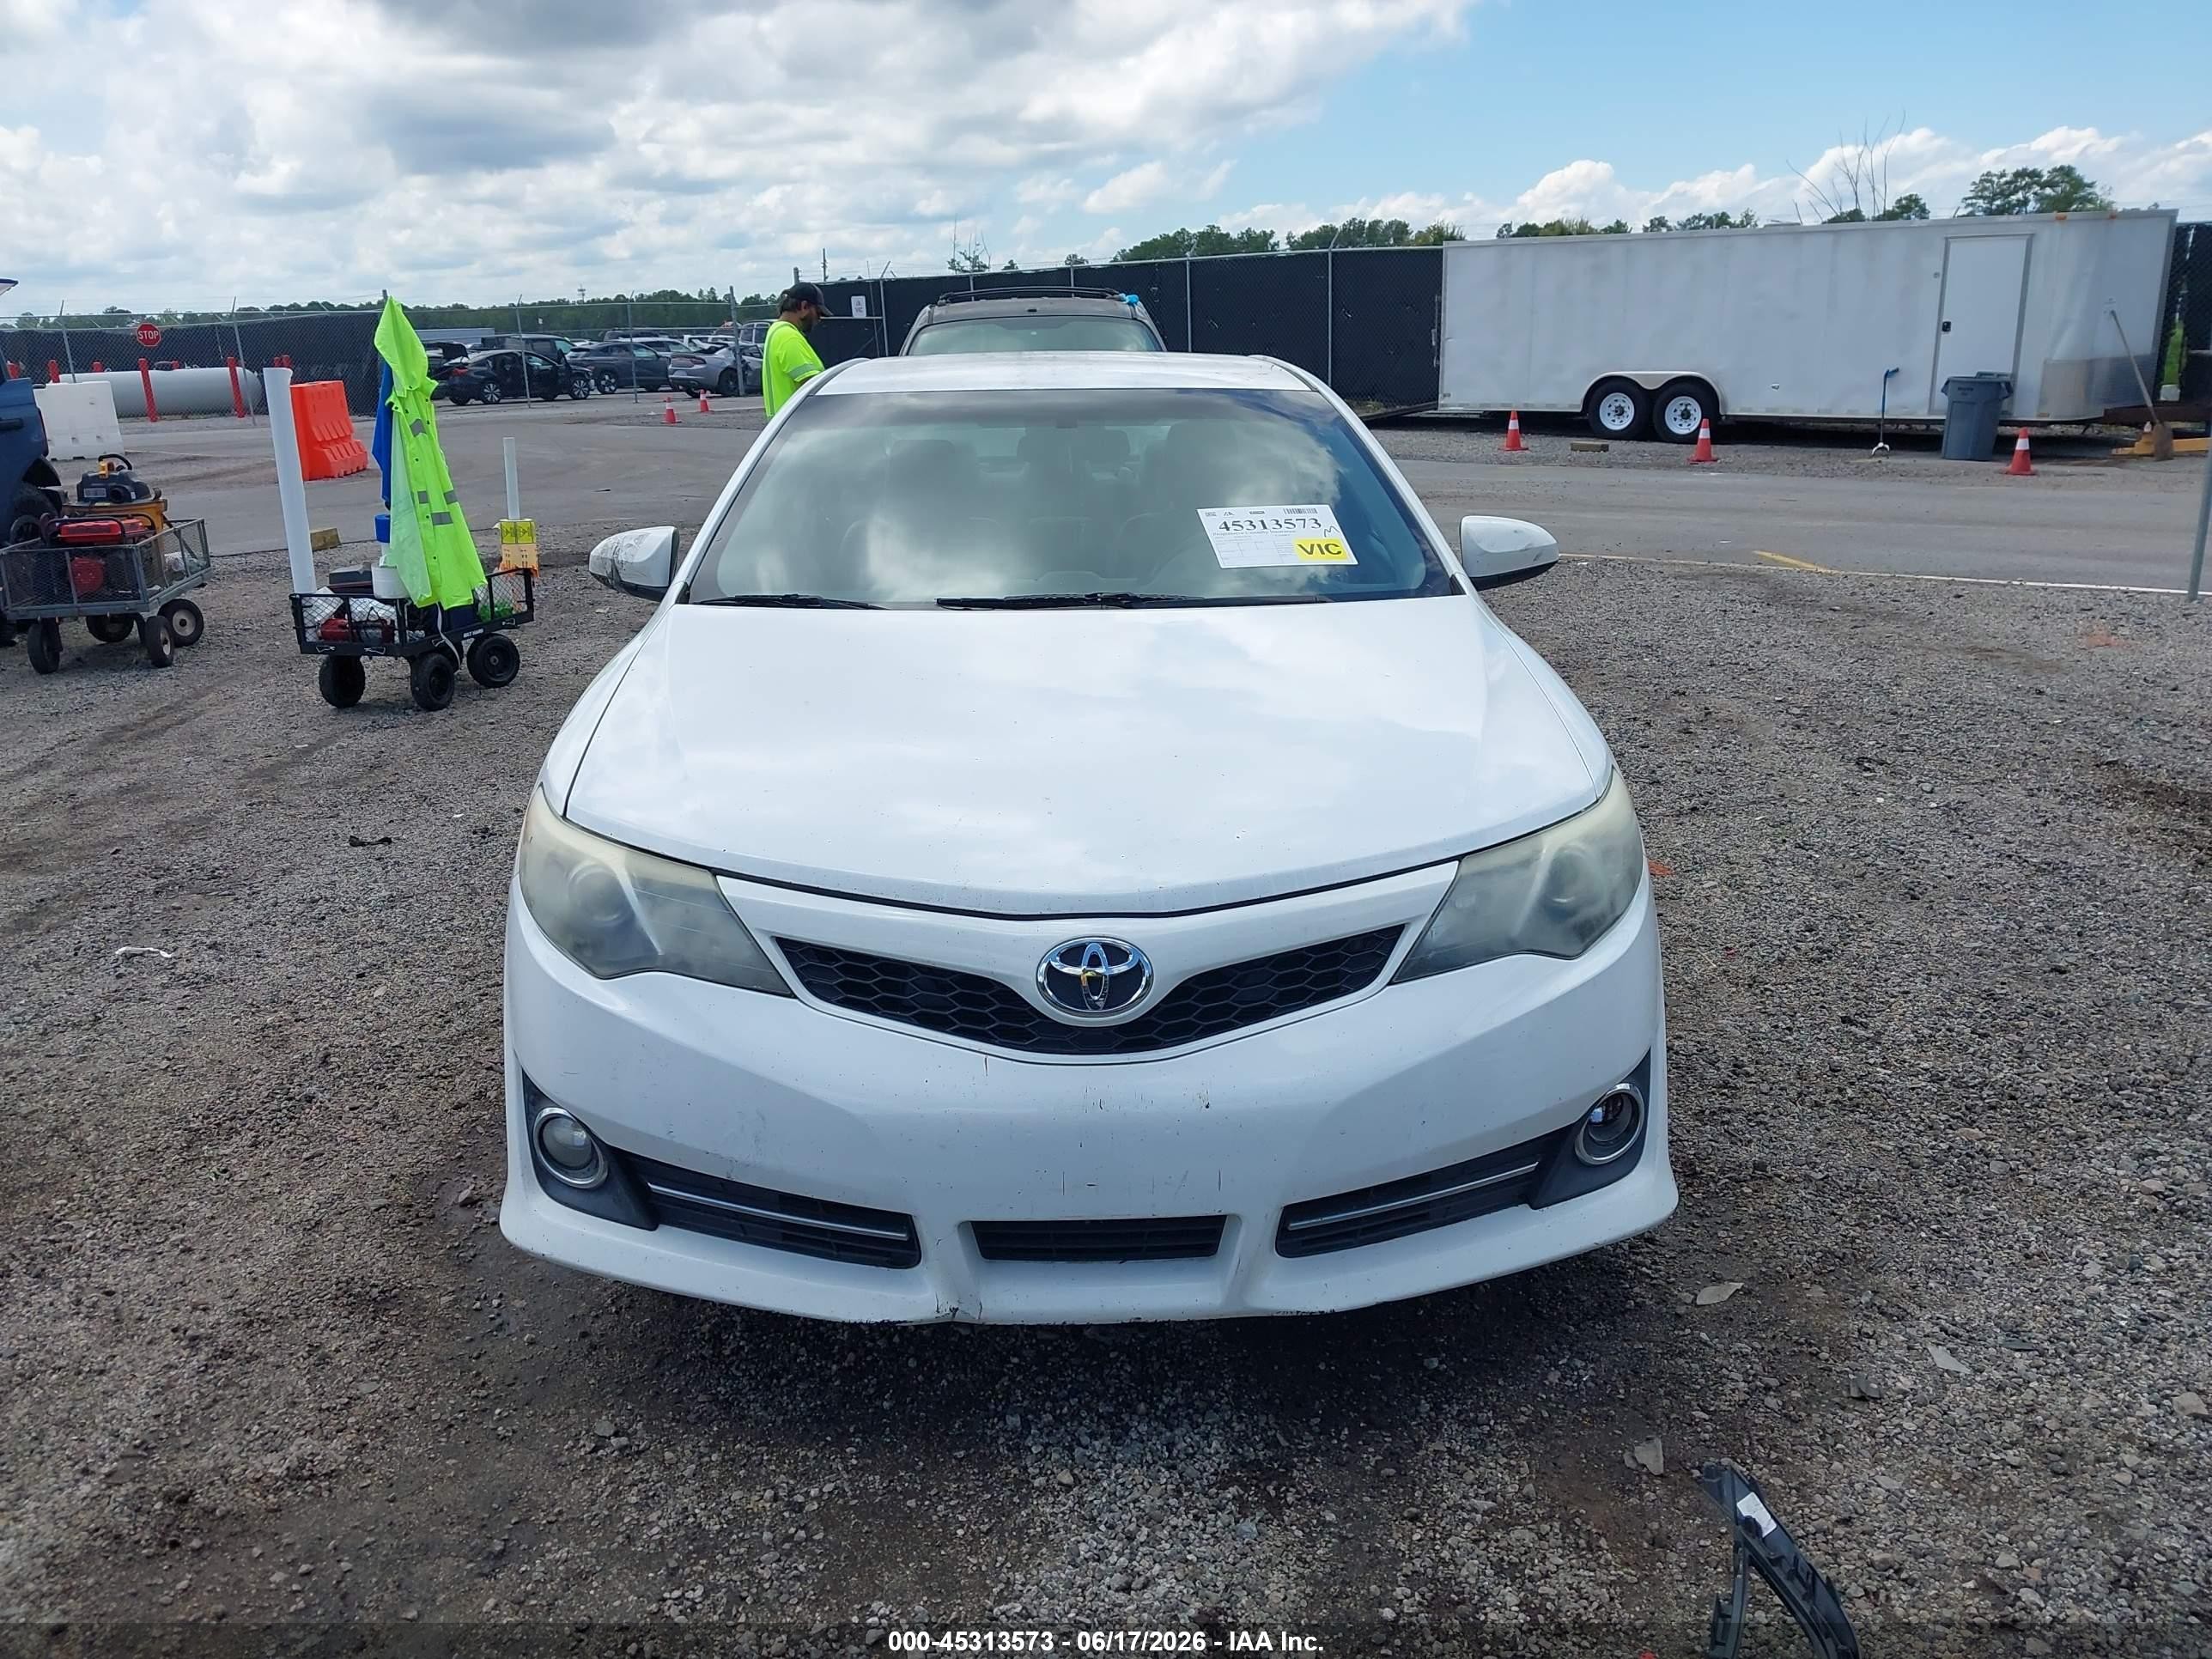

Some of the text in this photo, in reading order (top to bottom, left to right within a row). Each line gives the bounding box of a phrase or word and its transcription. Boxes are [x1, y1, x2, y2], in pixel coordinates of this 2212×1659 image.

[137, 330, 160, 340] STOP
[1218, 517, 1322, 532] 45313573
[1297, 543, 1342, 556] VIC
